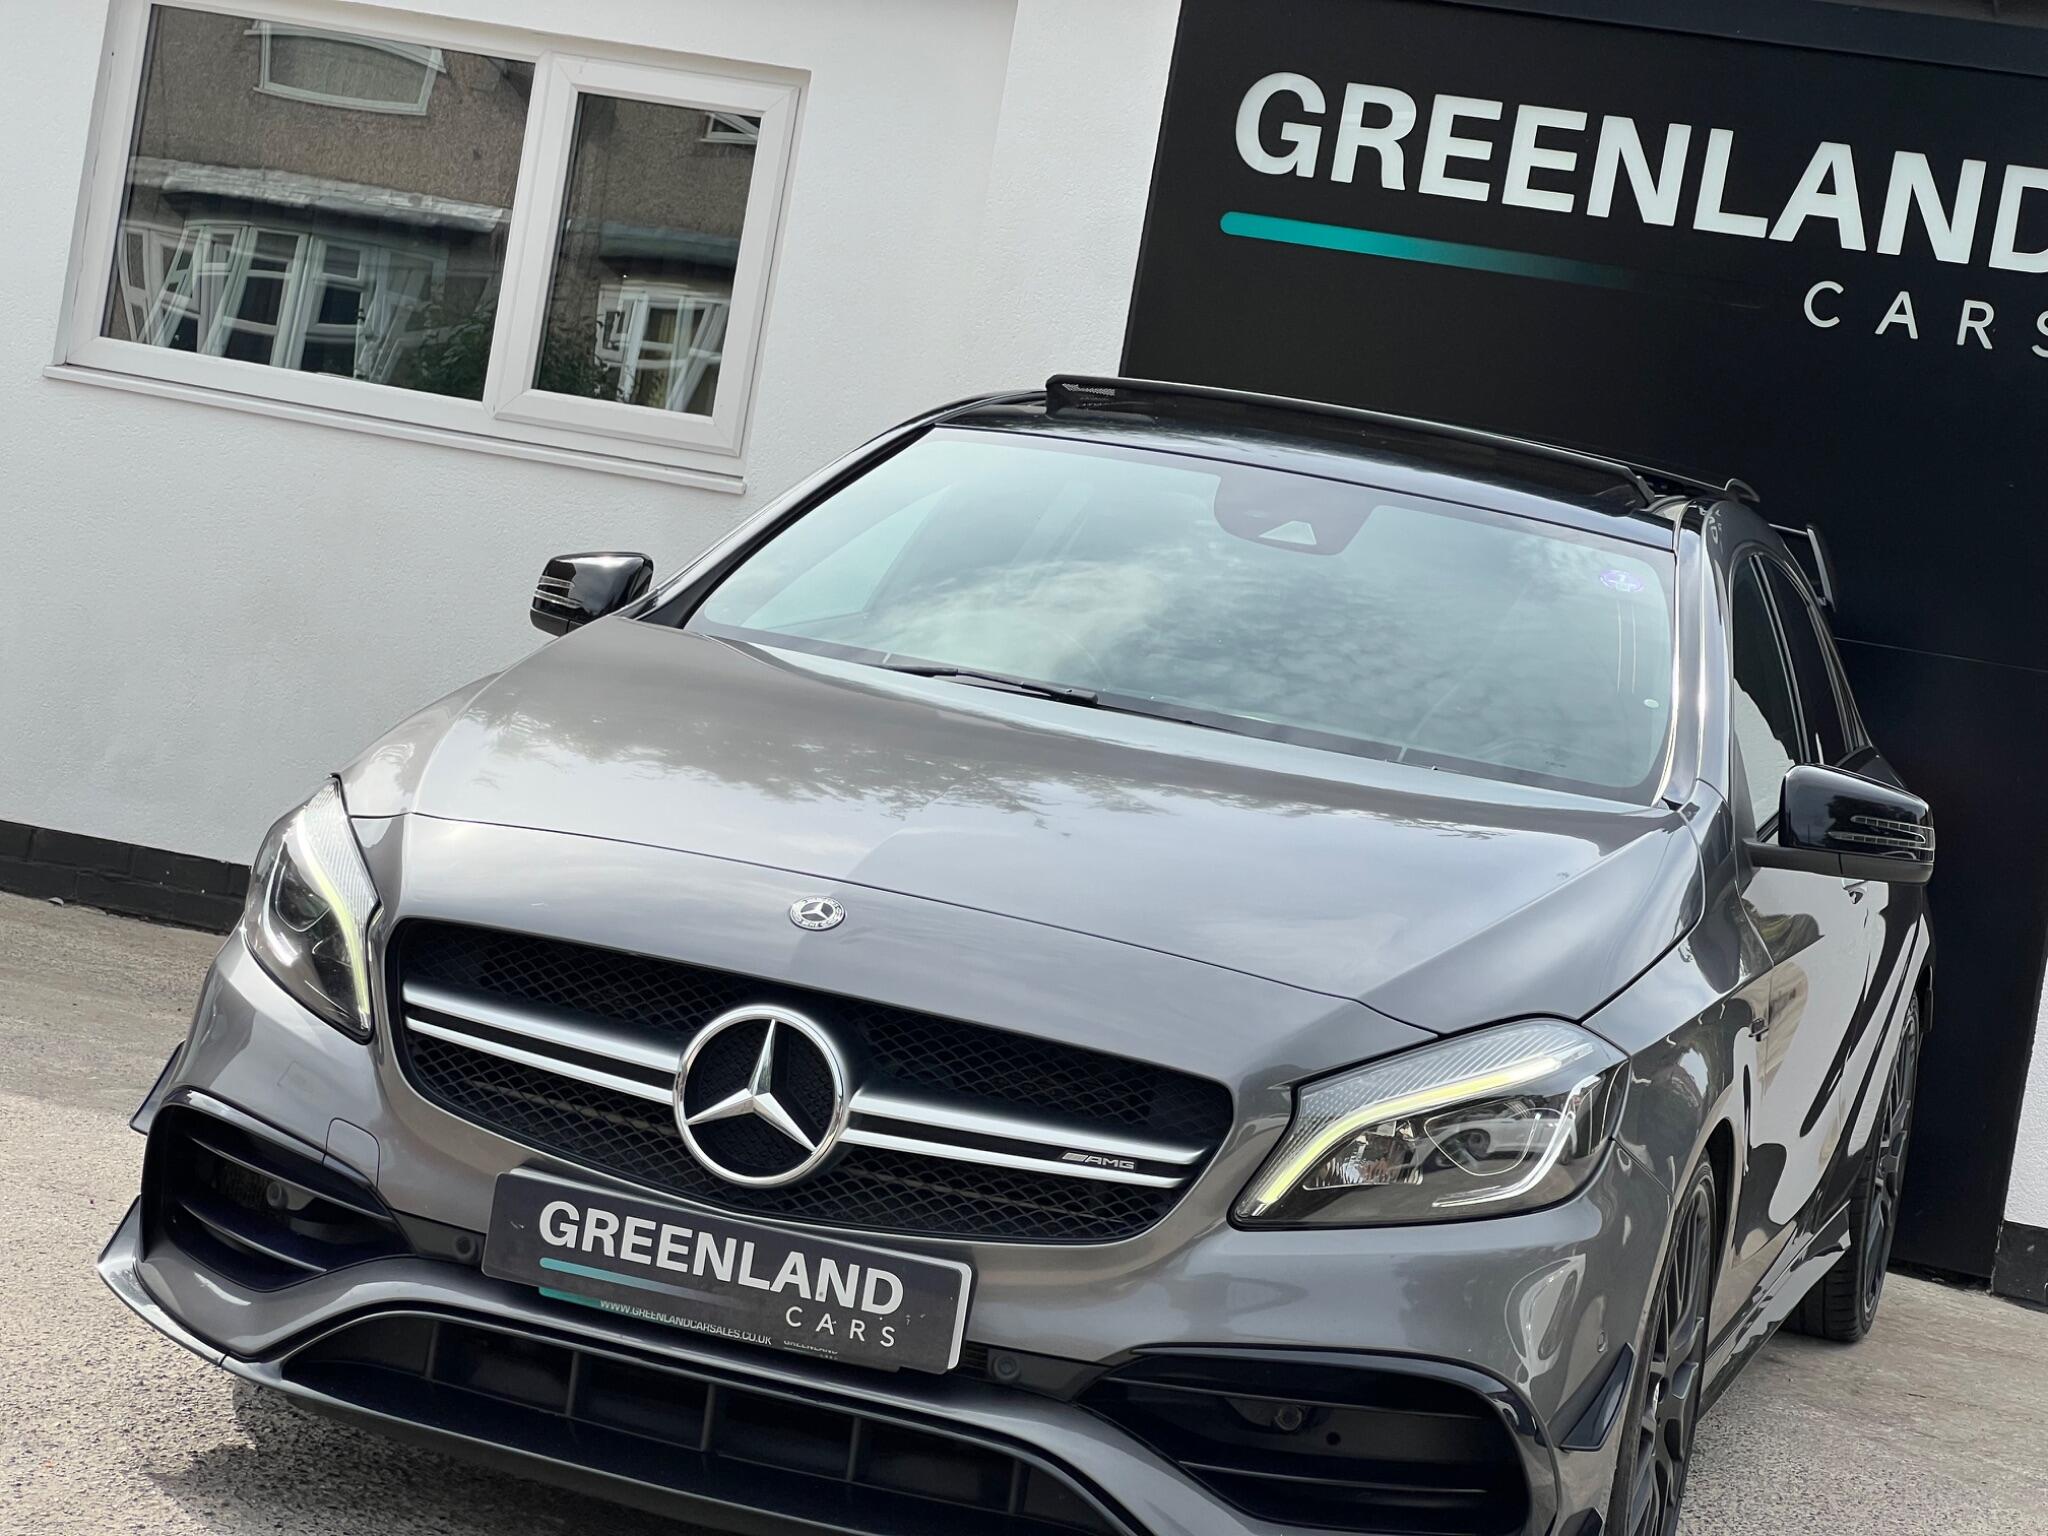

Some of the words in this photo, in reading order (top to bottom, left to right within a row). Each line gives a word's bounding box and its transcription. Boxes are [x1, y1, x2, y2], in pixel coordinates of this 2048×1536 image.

[1234, 71, 2048, 274] GREENLAND
[1084, 1155, 1135, 1170] AMG
[538, 1200, 904, 1316] GREENLAND
[785, 1305, 896, 1348] CARS
